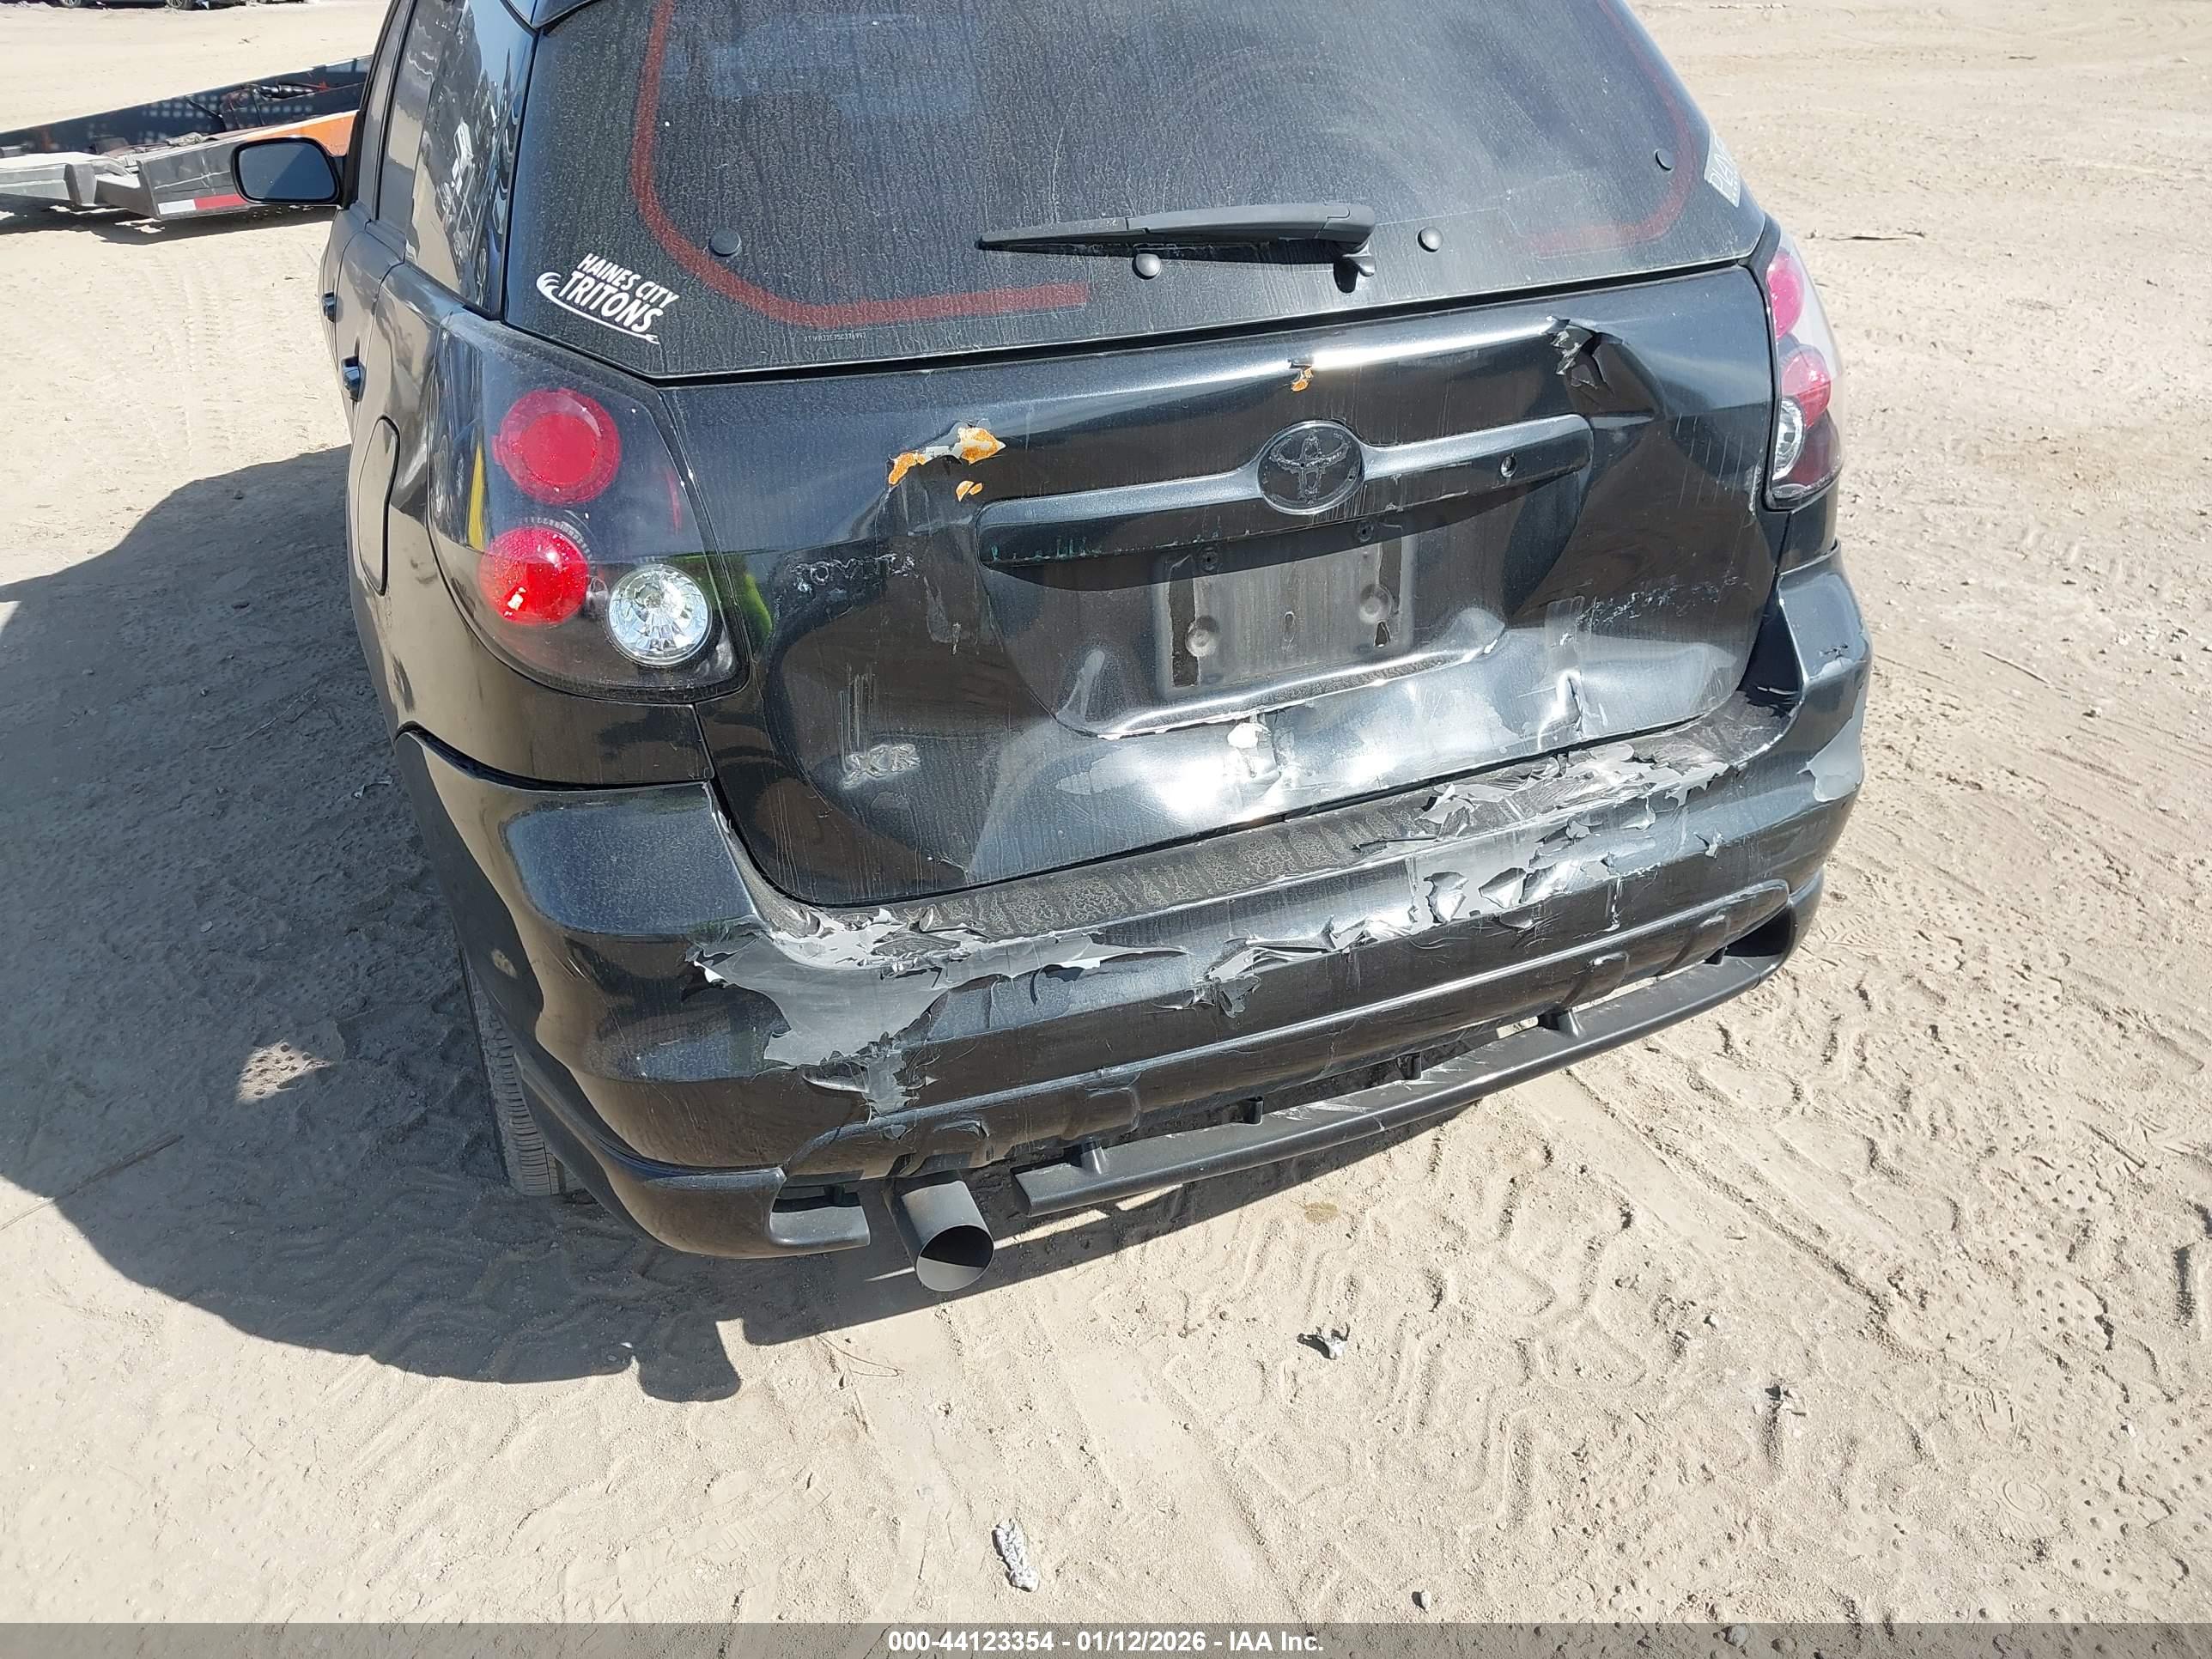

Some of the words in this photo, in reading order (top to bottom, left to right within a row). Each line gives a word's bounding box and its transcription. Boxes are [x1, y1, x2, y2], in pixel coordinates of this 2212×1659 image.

[559, 270, 663, 332] TRITONS
[577, 252, 641, 291] HAINES
[635, 281, 679, 308] CITY
